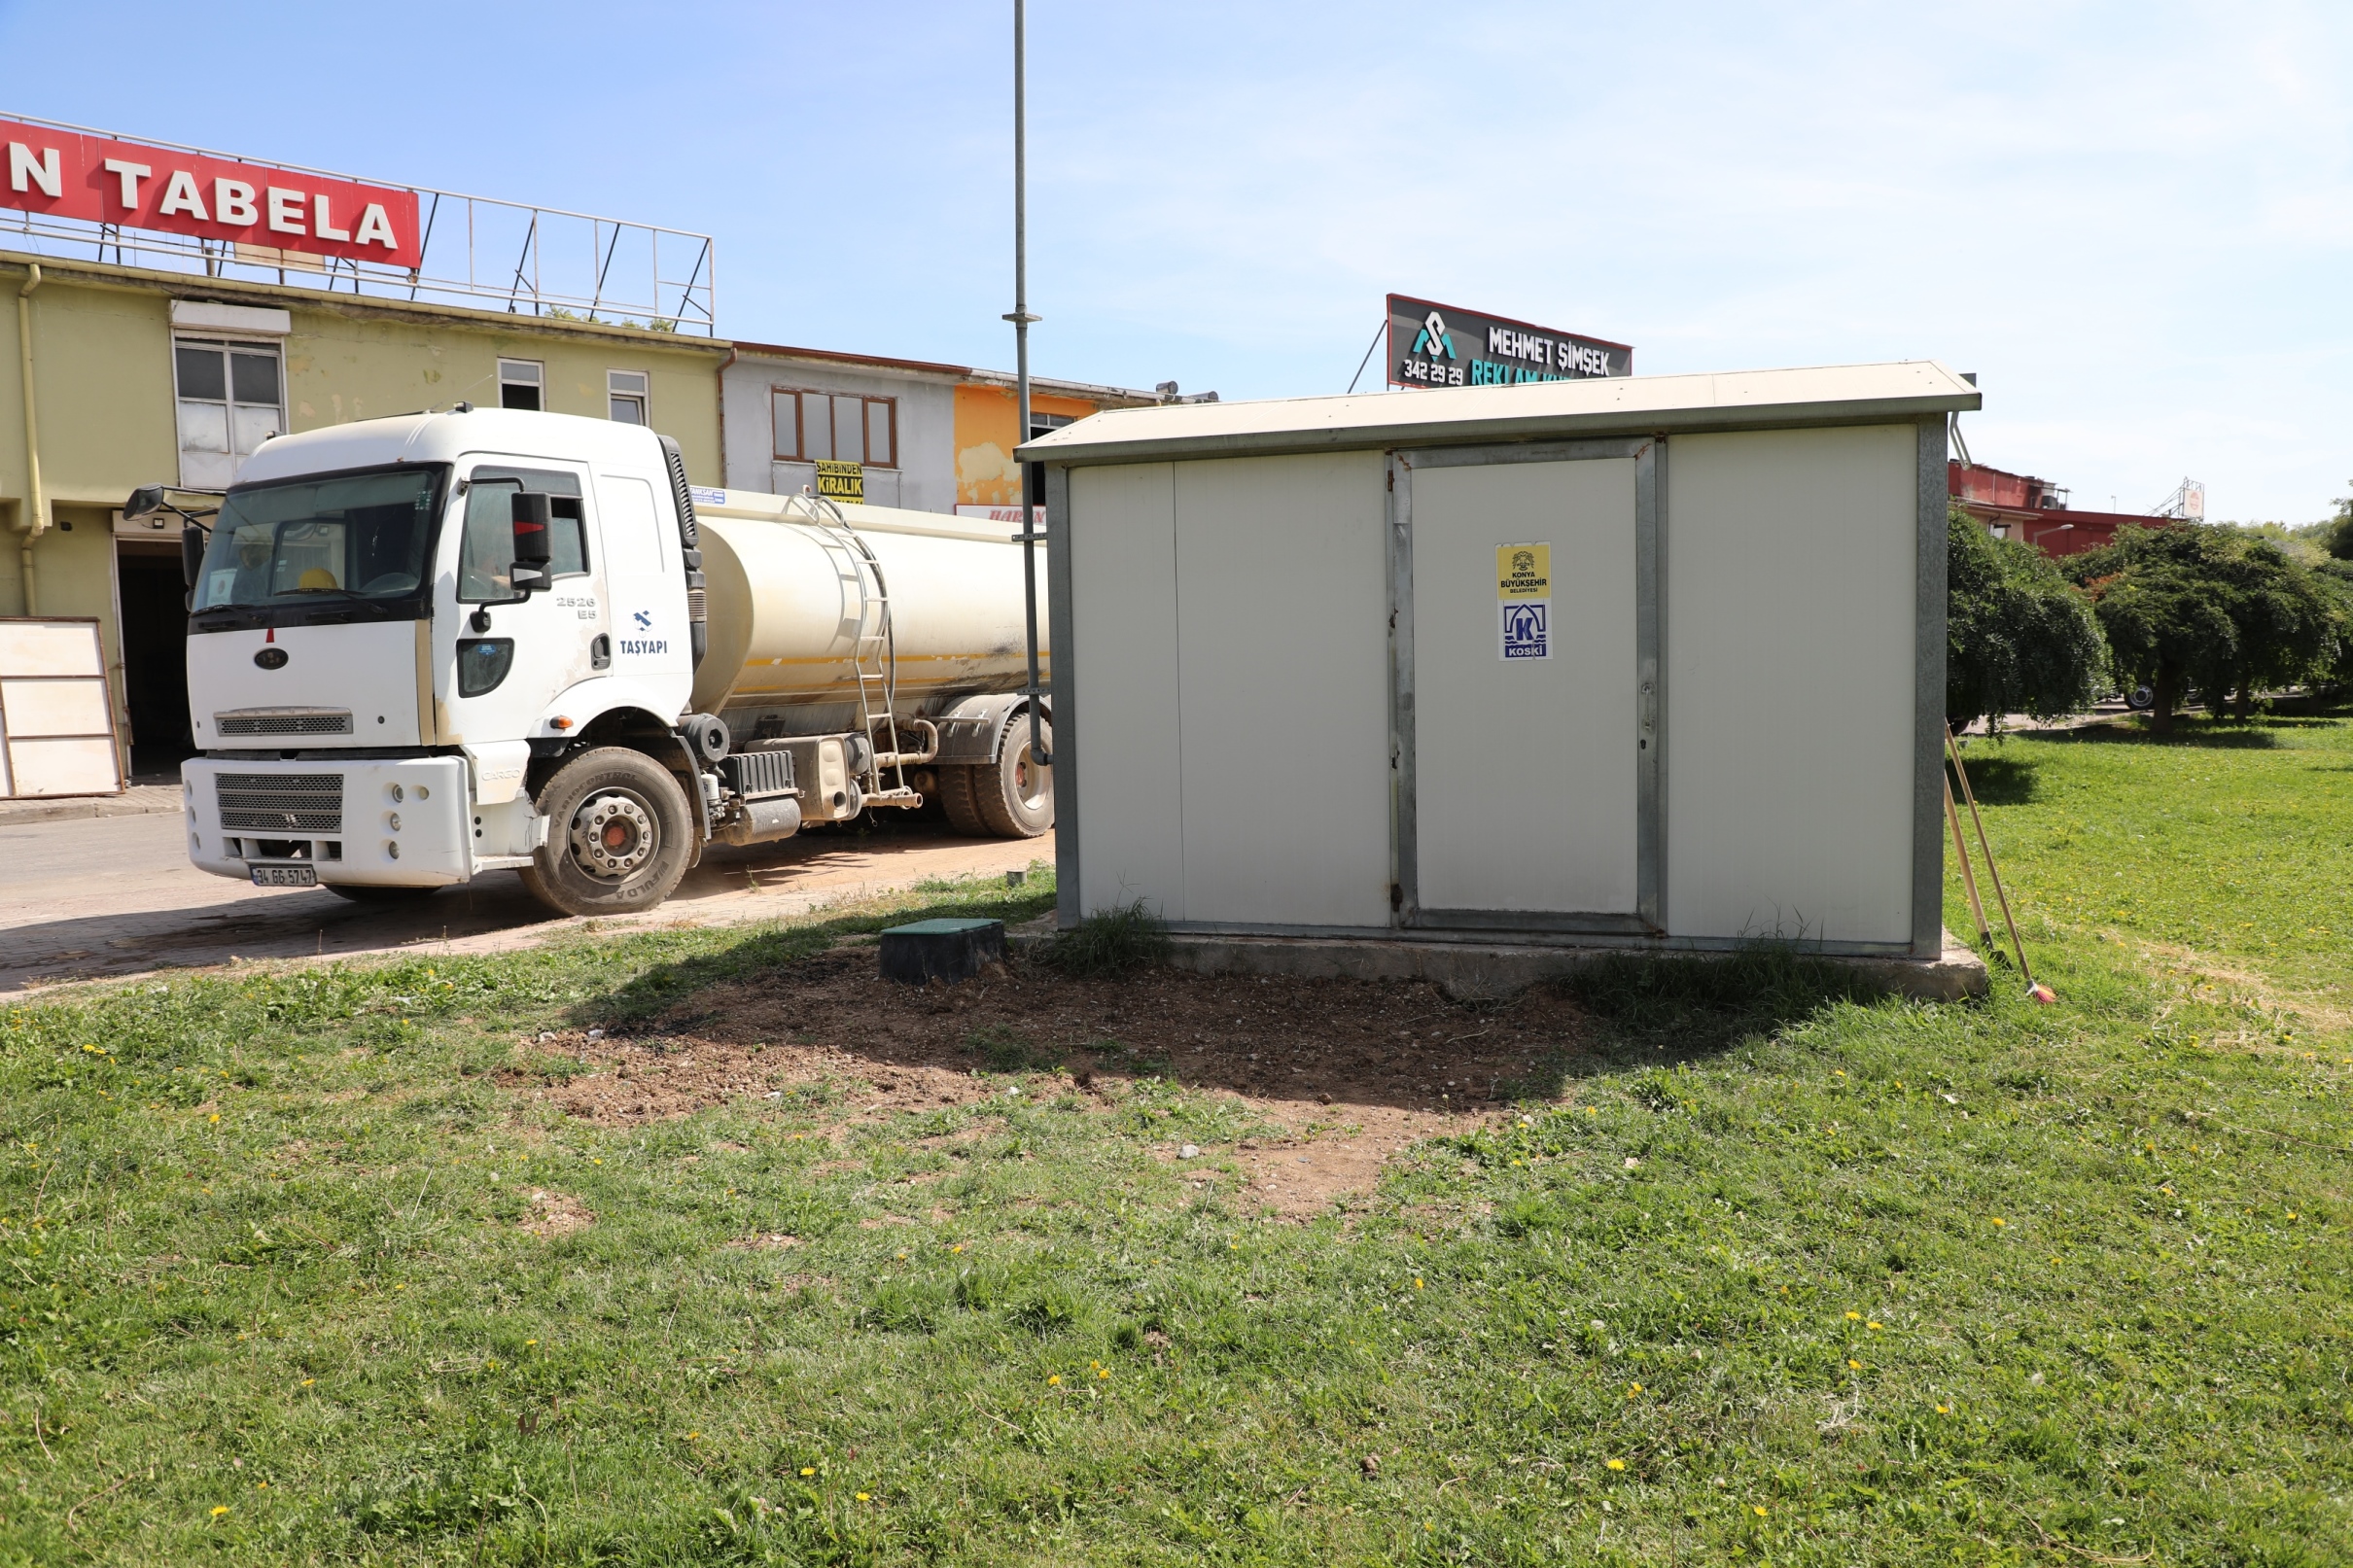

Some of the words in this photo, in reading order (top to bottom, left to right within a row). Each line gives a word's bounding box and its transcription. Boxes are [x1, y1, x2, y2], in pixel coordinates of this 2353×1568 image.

[104, 157, 399, 250] TABELA
[1489, 327, 1554, 365] MEHMET
[1404, 359, 1428, 380] 342
[1430, 364, 1446, 383] 29
[1448, 366, 1463, 386] 29
[989, 508, 1045, 524] HARN
[1500, 578, 1547, 588] BÜYÜKŞEHİR
[556, 597, 596, 608] 2526
[578, 610, 597, 620] E5
[620, 640, 668, 656] TAŞYAPI
[1508, 645, 1543, 656] KOSKİ
[257, 869, 268, 884] 34
[288, 869, 311, 884] 5747
[615, 869, 667, 900] FULDA
